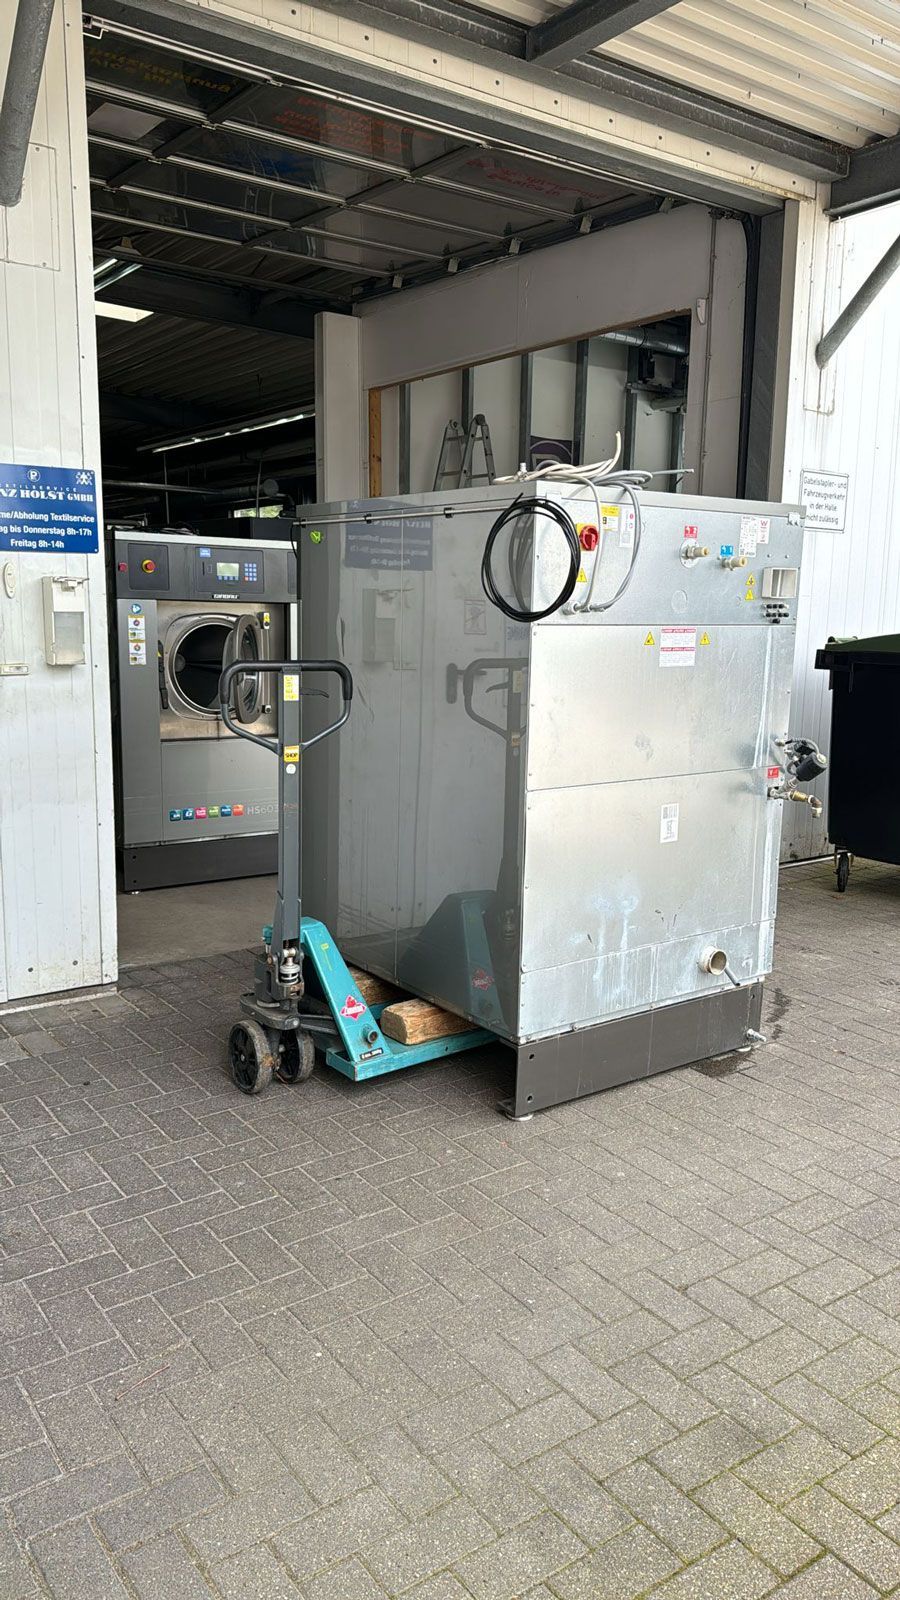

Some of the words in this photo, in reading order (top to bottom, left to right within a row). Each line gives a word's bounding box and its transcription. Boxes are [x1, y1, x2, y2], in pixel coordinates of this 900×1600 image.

[20, 490, 65, 500] HOLST
[67, 493, 93, 502] GMBH
[50, 513, 95, 523] Textilservice
[10, 525, 21, 533] bis
[23, 526, 65, 537] Donnerstag
[67, 528, 92, 536] 8h-17h
[11, 539, 37, 549] Freitag
[38, 540, 64, 548] 8h-14h
